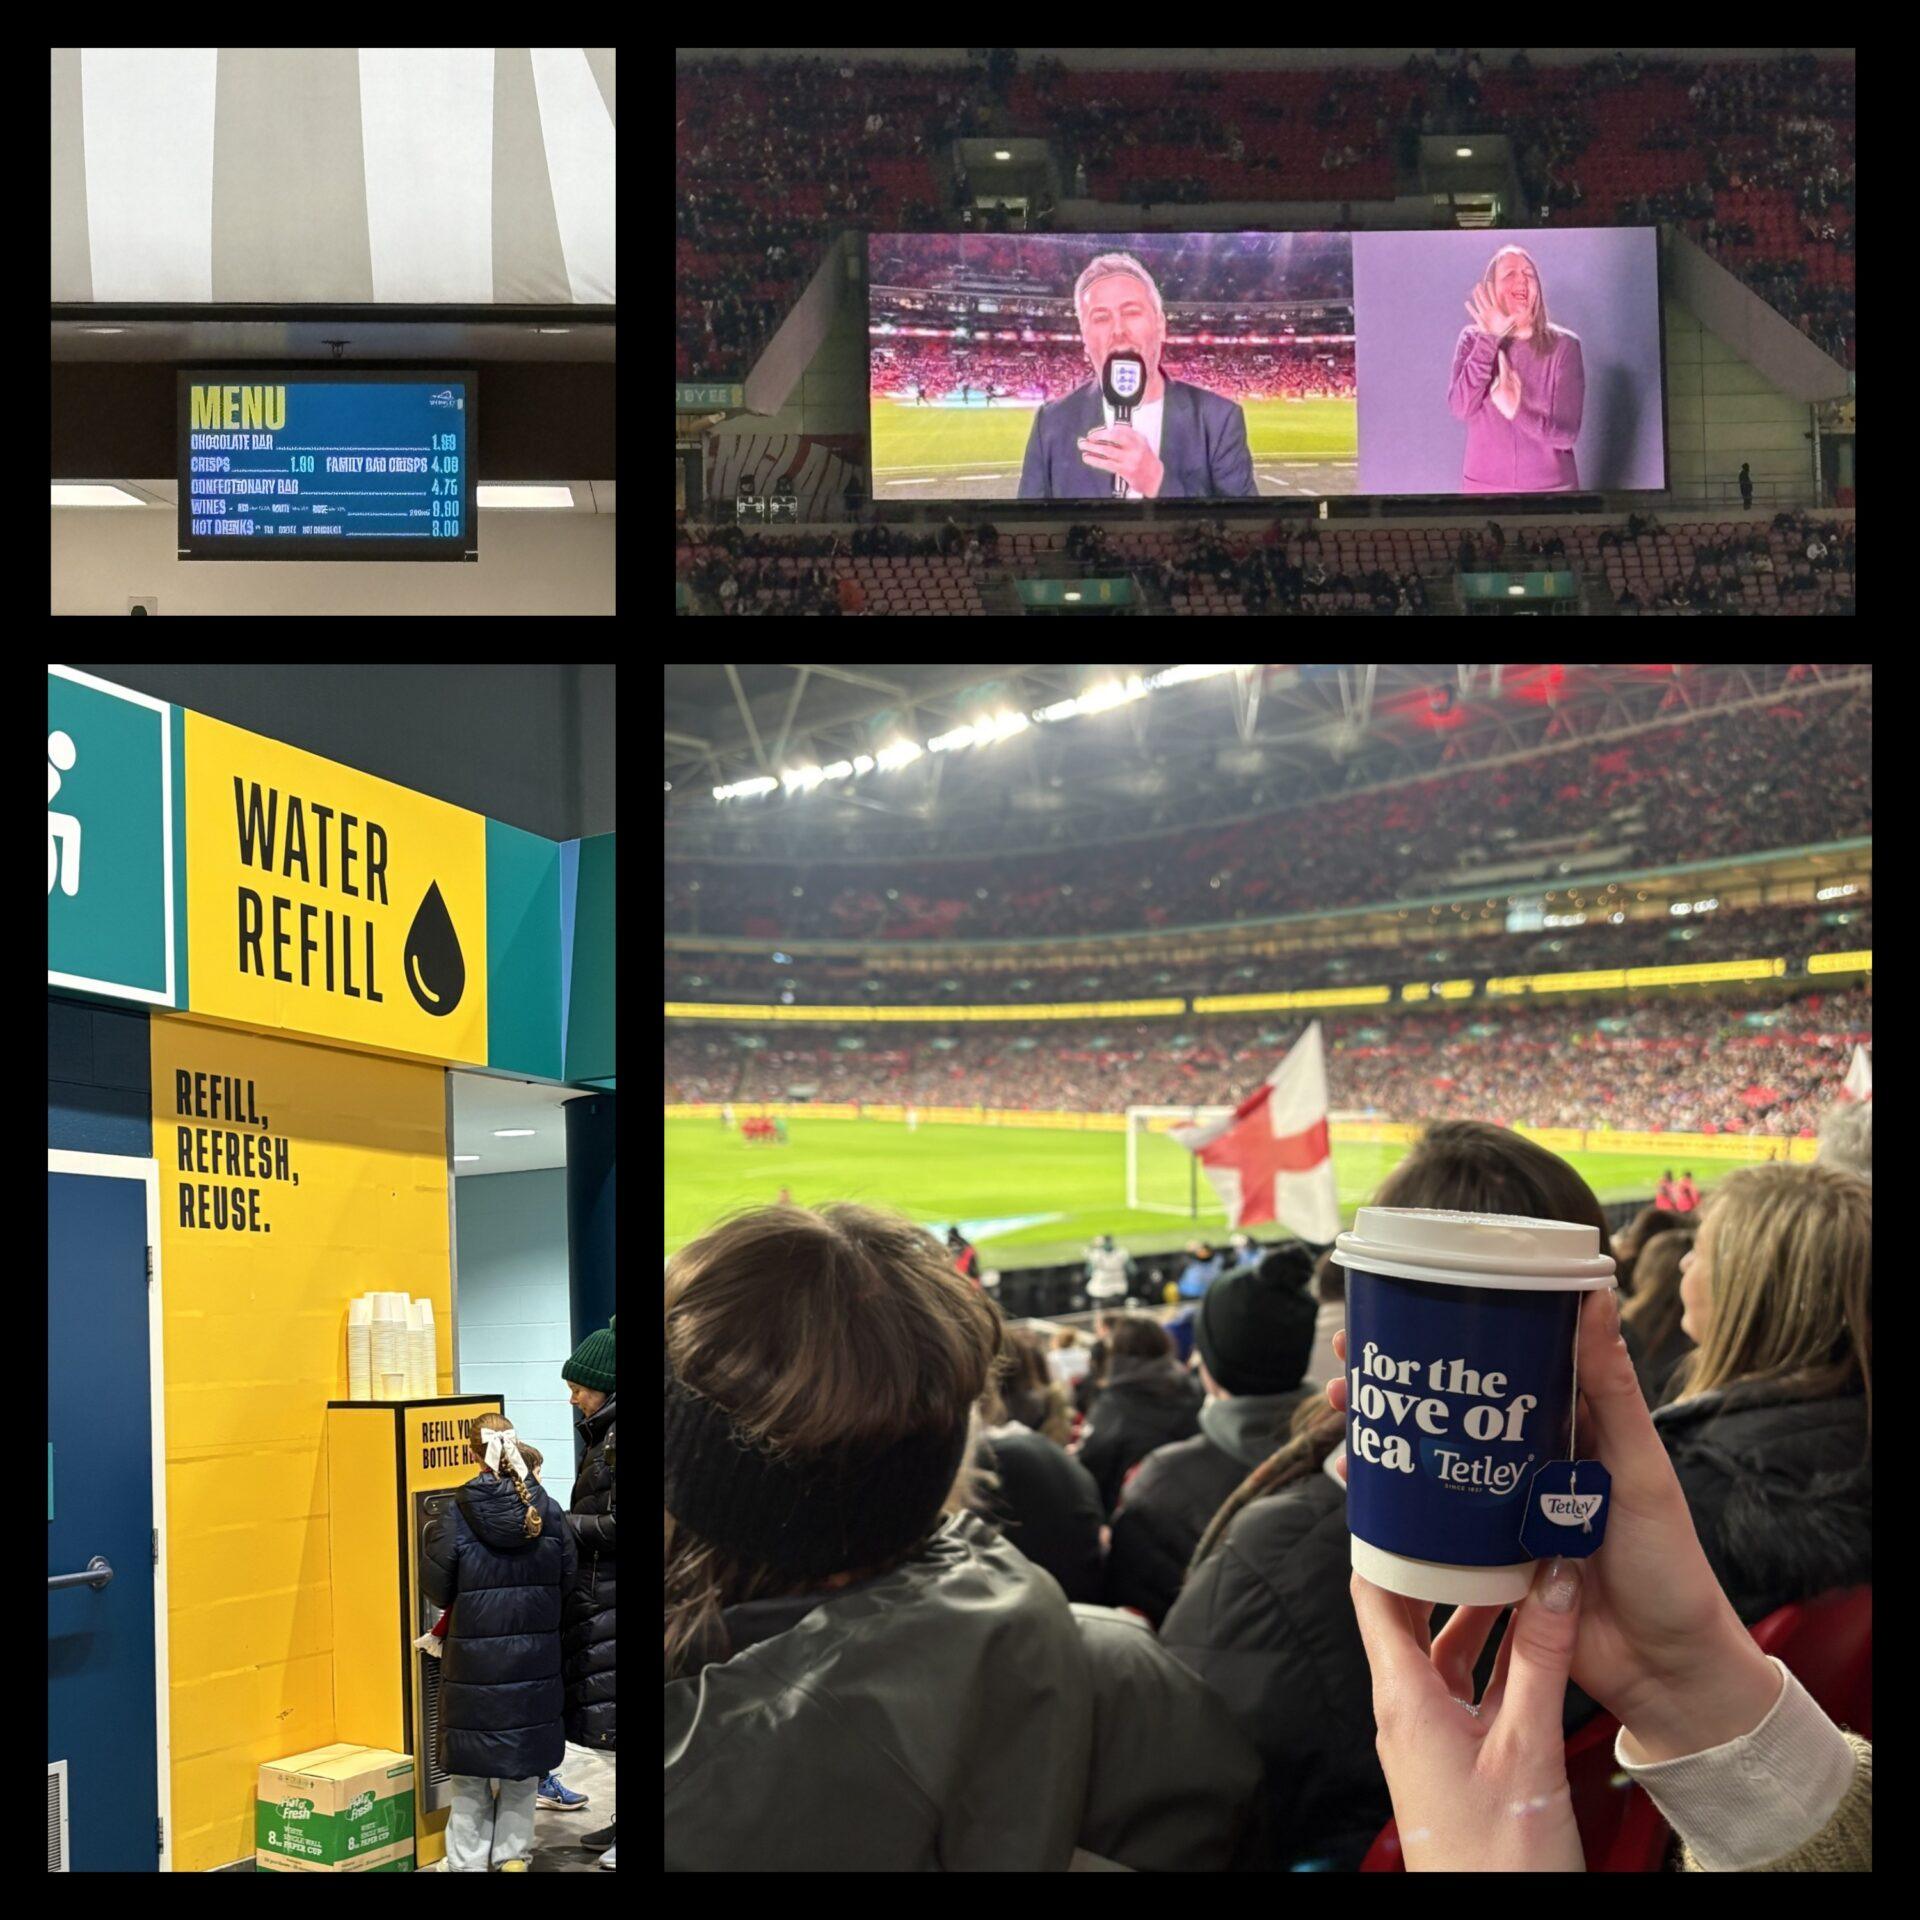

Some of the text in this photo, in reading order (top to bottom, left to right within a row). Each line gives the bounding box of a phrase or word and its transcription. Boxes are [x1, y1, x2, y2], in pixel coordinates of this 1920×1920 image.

[190, 385, 286, 430] MENU
[191, 434, 250, 450] CHOCOLATE
[252, 434, 274, 450] BAR
[191, 456, 231, 472] CRISPS
[326, 457, 364, 473] FAMILY
[365, 457, 387, 473] BAG
[388, 457, 428, 473] CRISPS
[191, 479, 276, 495] CONFECTIONARY
[277, 479, 299, 495] BAG
[191, 499, 226, 515] WINES
[192, 519, 213, 536] HOT
[214, 519, 254, 536] DRINKS
[233, 775, 390, 906] WATER
[237, 885, 385, 1004] REFILL
[175, 1068, 269, 1130] REFILL,
[177, 1125, 300, 1187] REFRESH,
[179, 1182, 272, 1234] REUSE.
[1362, 1341, 1508, 1399] for the
[1350, 1366, 1538, 1442] love of
[422, 1420, 455, 1443] REFILL
[1351, 1414, 1416, 1474] tea
[423, 1446, 459, 1469] BOTTLE
[1434, 1448, 1529, 1496] Tetley
[282, 1806, 311, 1820] Fresh
